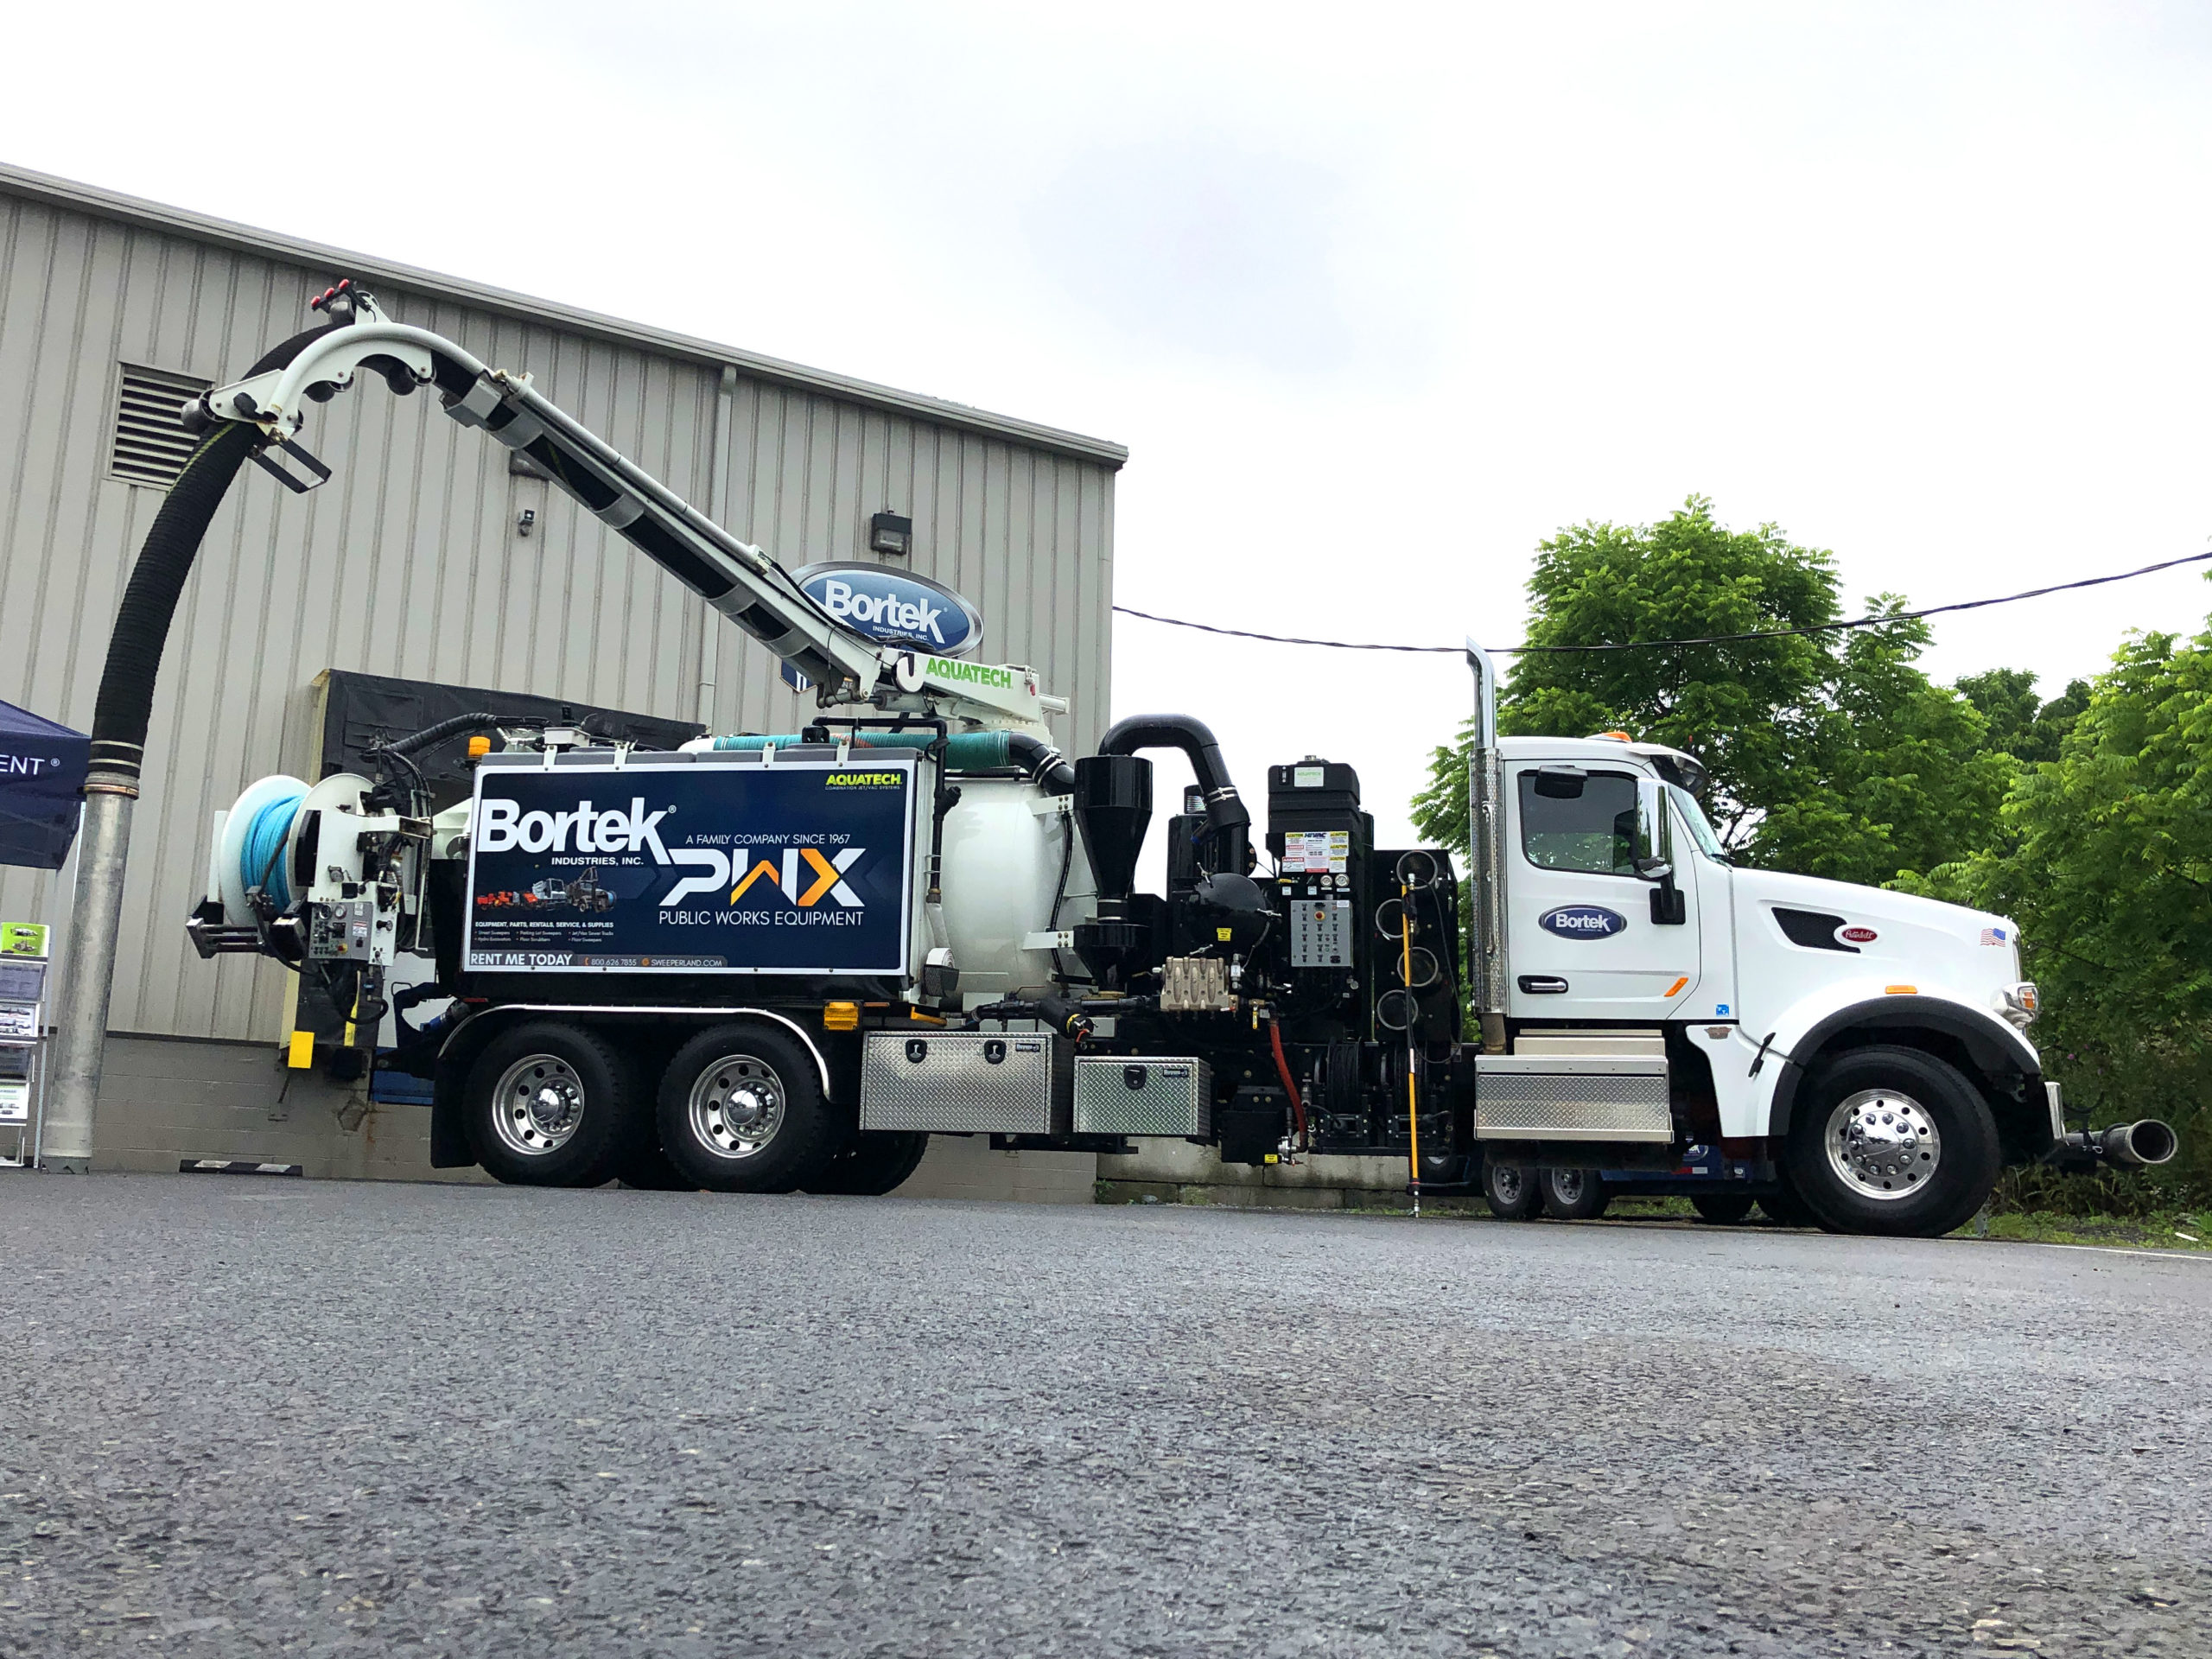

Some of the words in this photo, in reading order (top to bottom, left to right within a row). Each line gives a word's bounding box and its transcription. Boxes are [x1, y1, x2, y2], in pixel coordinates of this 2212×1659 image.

[825, 580, 945, 645] Bortek
[926, 658, 1011, 689] AQUATECH
[825, 773, 901, 785] AQUATECH
[685, 835, 693, 844] A
[696, 834, 731, 845] FAMILY
[734, 834, 791, 845] COMPANY
[792, 834, 825, 844] SINCE
[829, 834, 851, 844] 1967
[551, 857, 619, 866] INDUSTRIES,
[659, 911, 712, 925] PUBLIC
[715, 912, 771, 925] WORKS
[774, 912, 864, 926] EQUIPMENT
[1555, 913, 1611, 932] Bortek
[470, 953, 503, 965] RENT
[505, 954, 525, 965] ME
[529, 954, 573, 966] TODAY
